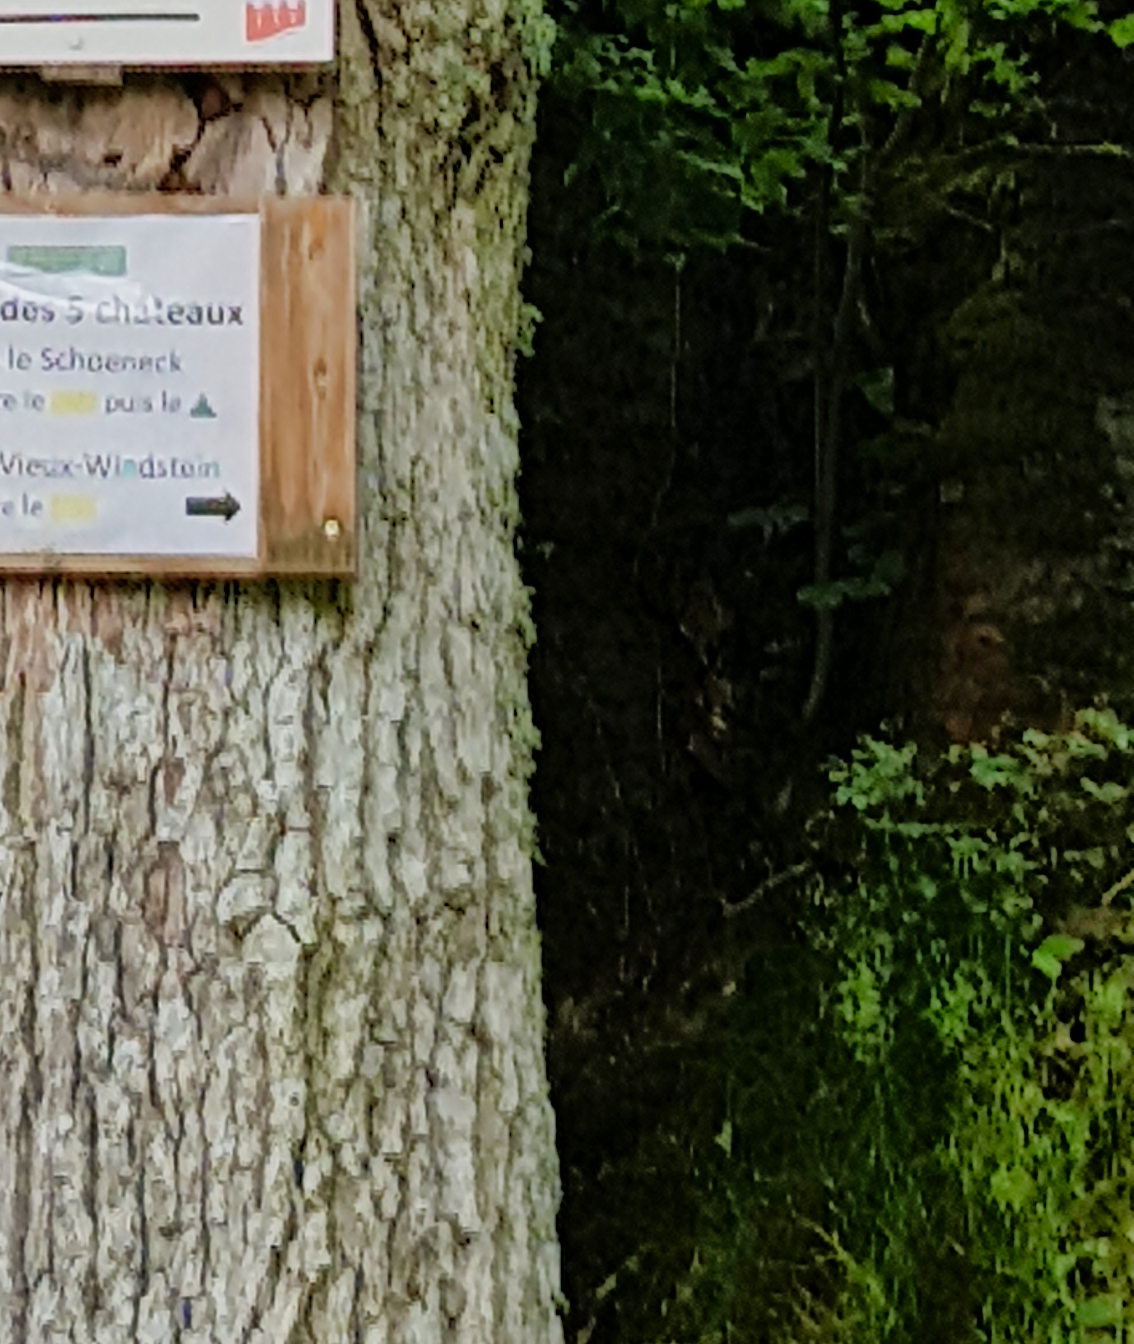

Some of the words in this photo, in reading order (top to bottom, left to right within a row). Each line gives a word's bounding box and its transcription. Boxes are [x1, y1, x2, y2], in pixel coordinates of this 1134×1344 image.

[0, 296, 55, 324] des
[66, 294, 84, 325] 5
[8, 345, 32, 371] le
[40, 346, 183, 374] Schoeneck
[24, 391, 45, 412] le
[105, 394, 154, 416] puis
[0, 451, 221, 479] Vieux-Windstein
[22, 491, 43, 516] le
